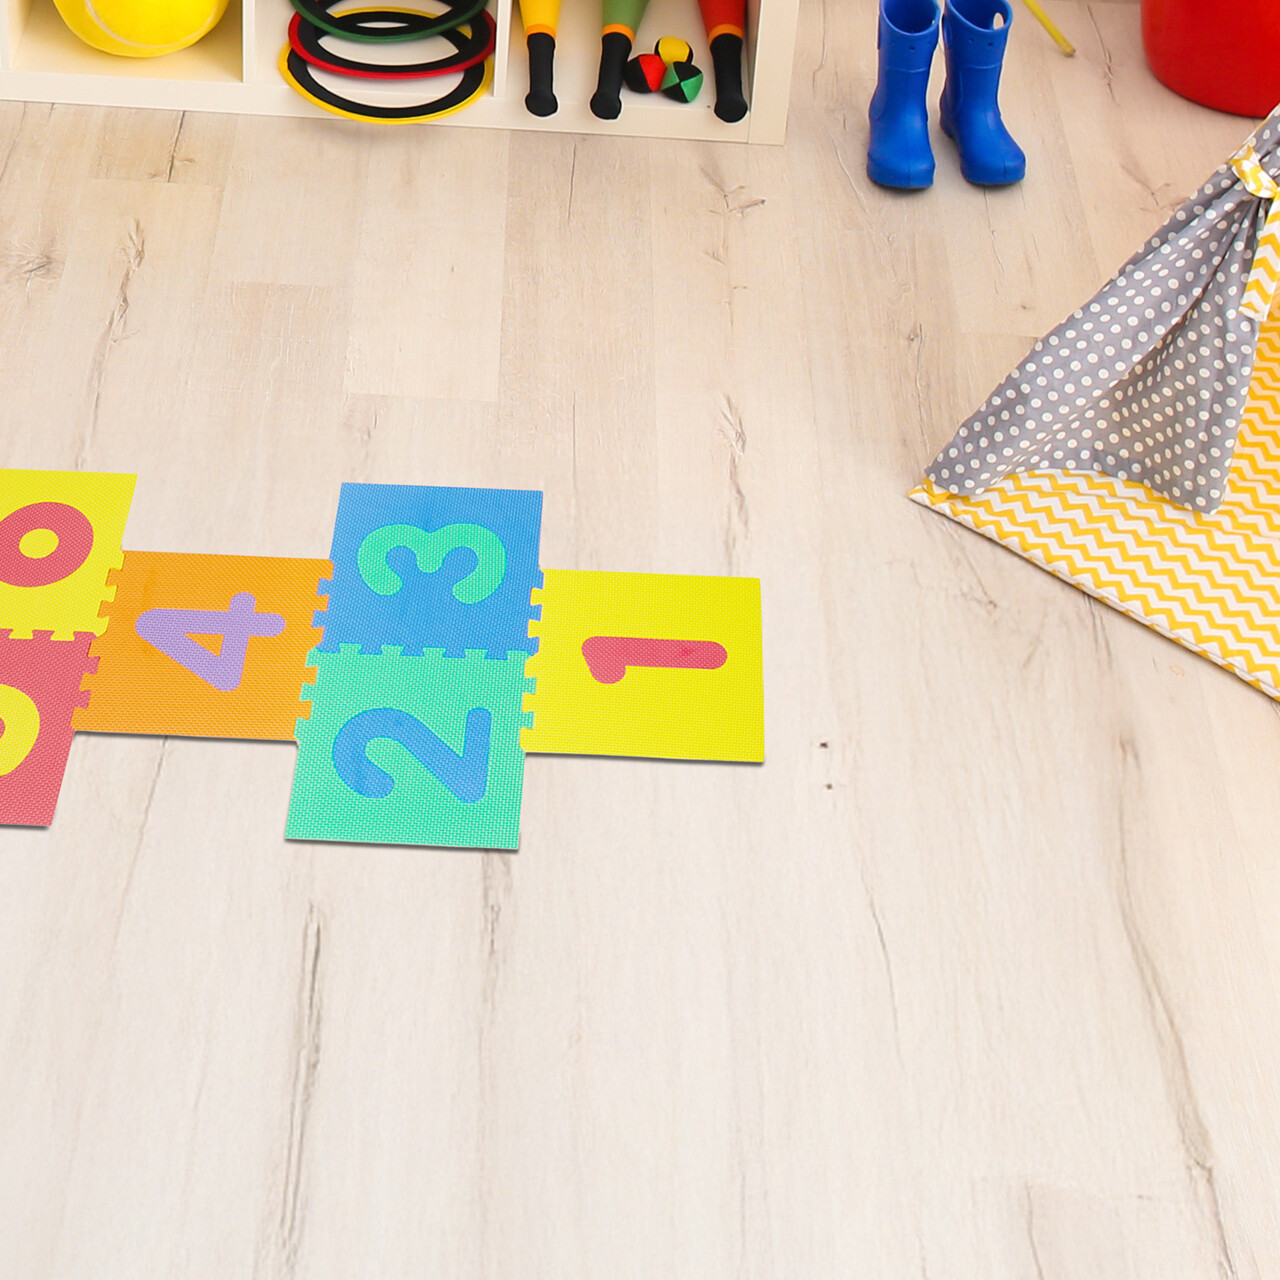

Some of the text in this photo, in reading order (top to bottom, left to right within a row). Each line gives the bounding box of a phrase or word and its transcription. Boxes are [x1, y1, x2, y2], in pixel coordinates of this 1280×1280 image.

[357, 523, 507, 604] 3
[135, 592, 286, 692] 4
[581, 636, 728, 684] 1
[332, 707, 493, 803] 2
